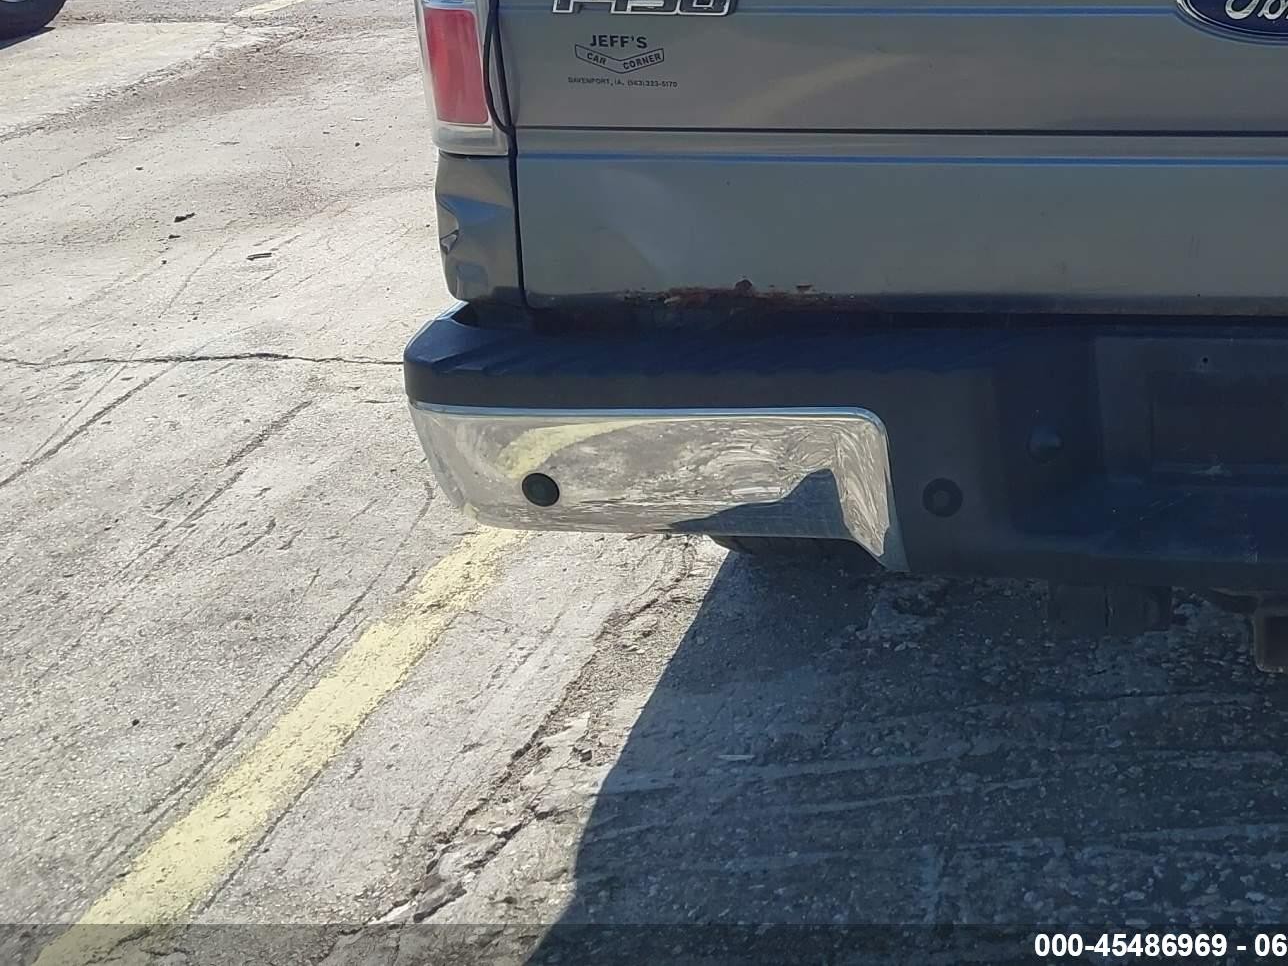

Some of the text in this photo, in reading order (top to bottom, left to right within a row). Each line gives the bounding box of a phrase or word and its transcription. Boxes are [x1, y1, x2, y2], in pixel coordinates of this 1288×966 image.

[590, 34, 648, 49] JEFF'S
[586, 51, 662, 70] CAR CORNER
